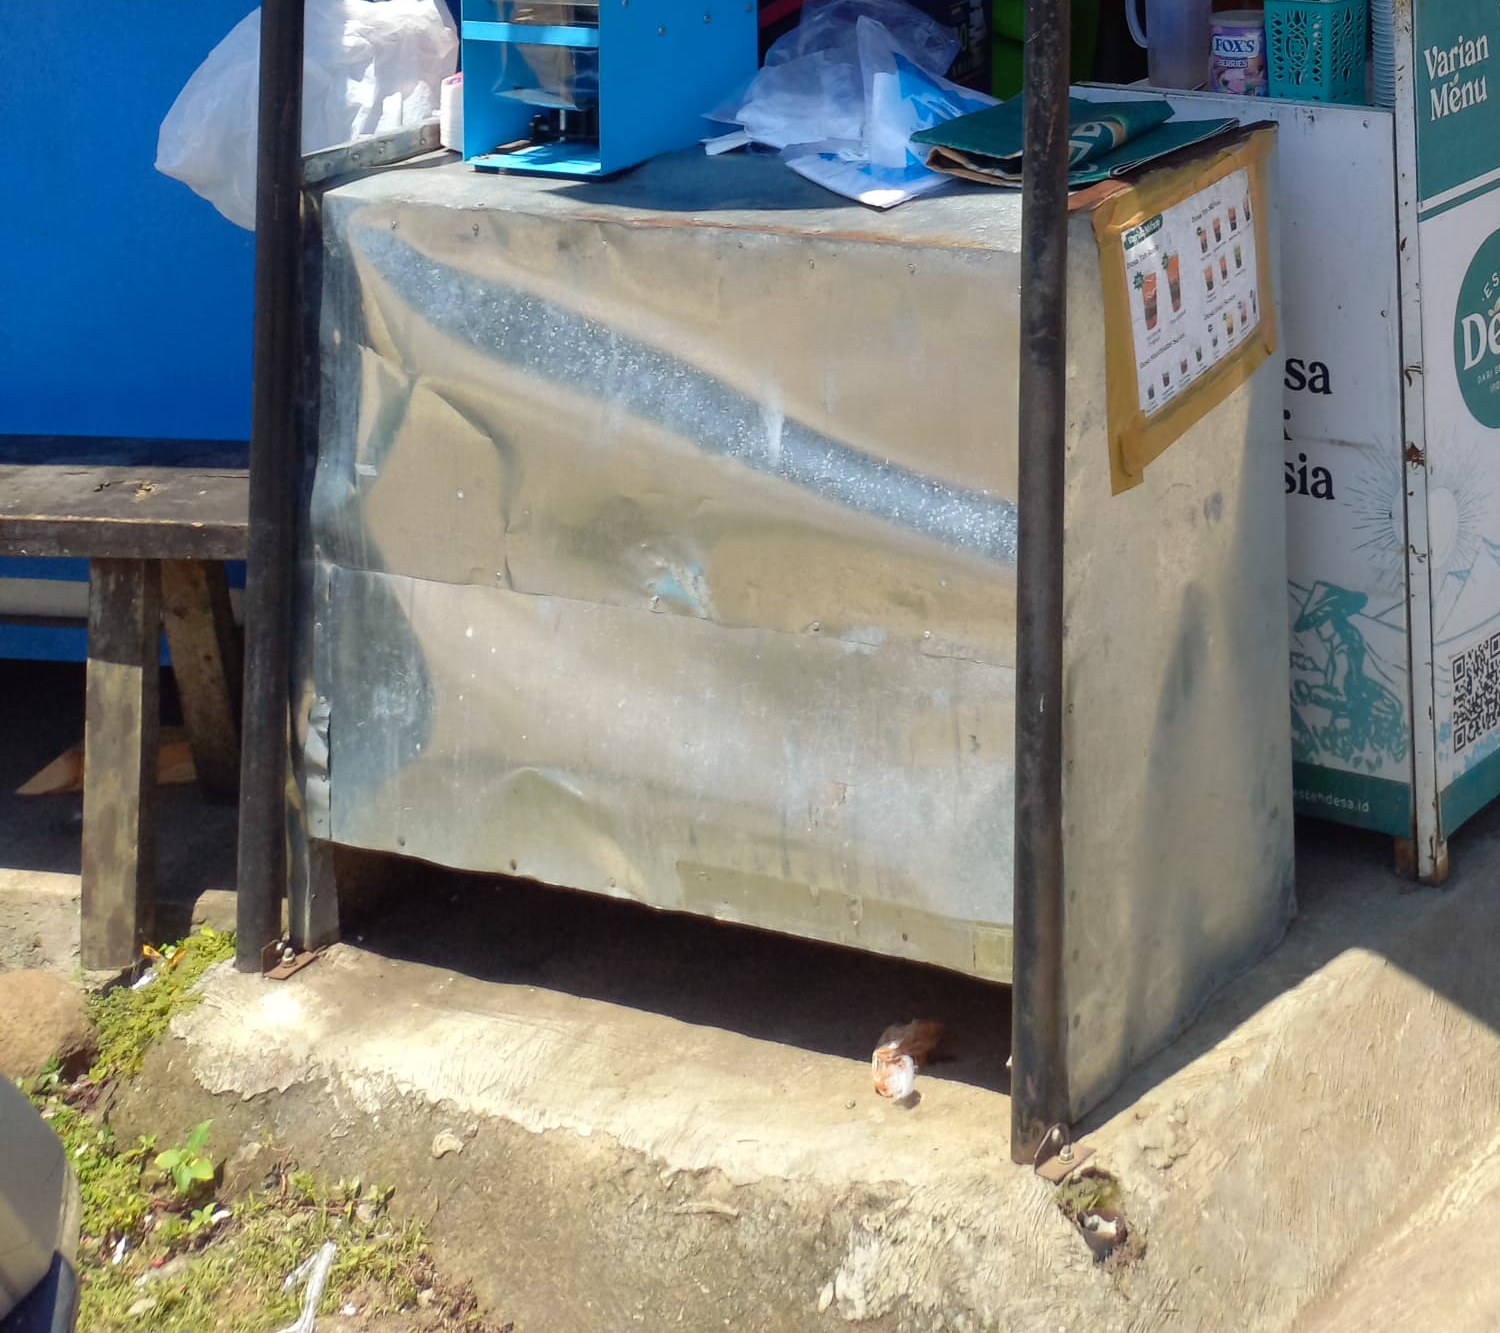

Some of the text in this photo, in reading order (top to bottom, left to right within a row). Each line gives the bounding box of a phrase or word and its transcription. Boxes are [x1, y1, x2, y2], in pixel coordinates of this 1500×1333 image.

[1214, 37, 1255, 53] FOX'S
[1424, 34, 1489, 81] Varian
[1430, 75, 1488, 122] Menu
